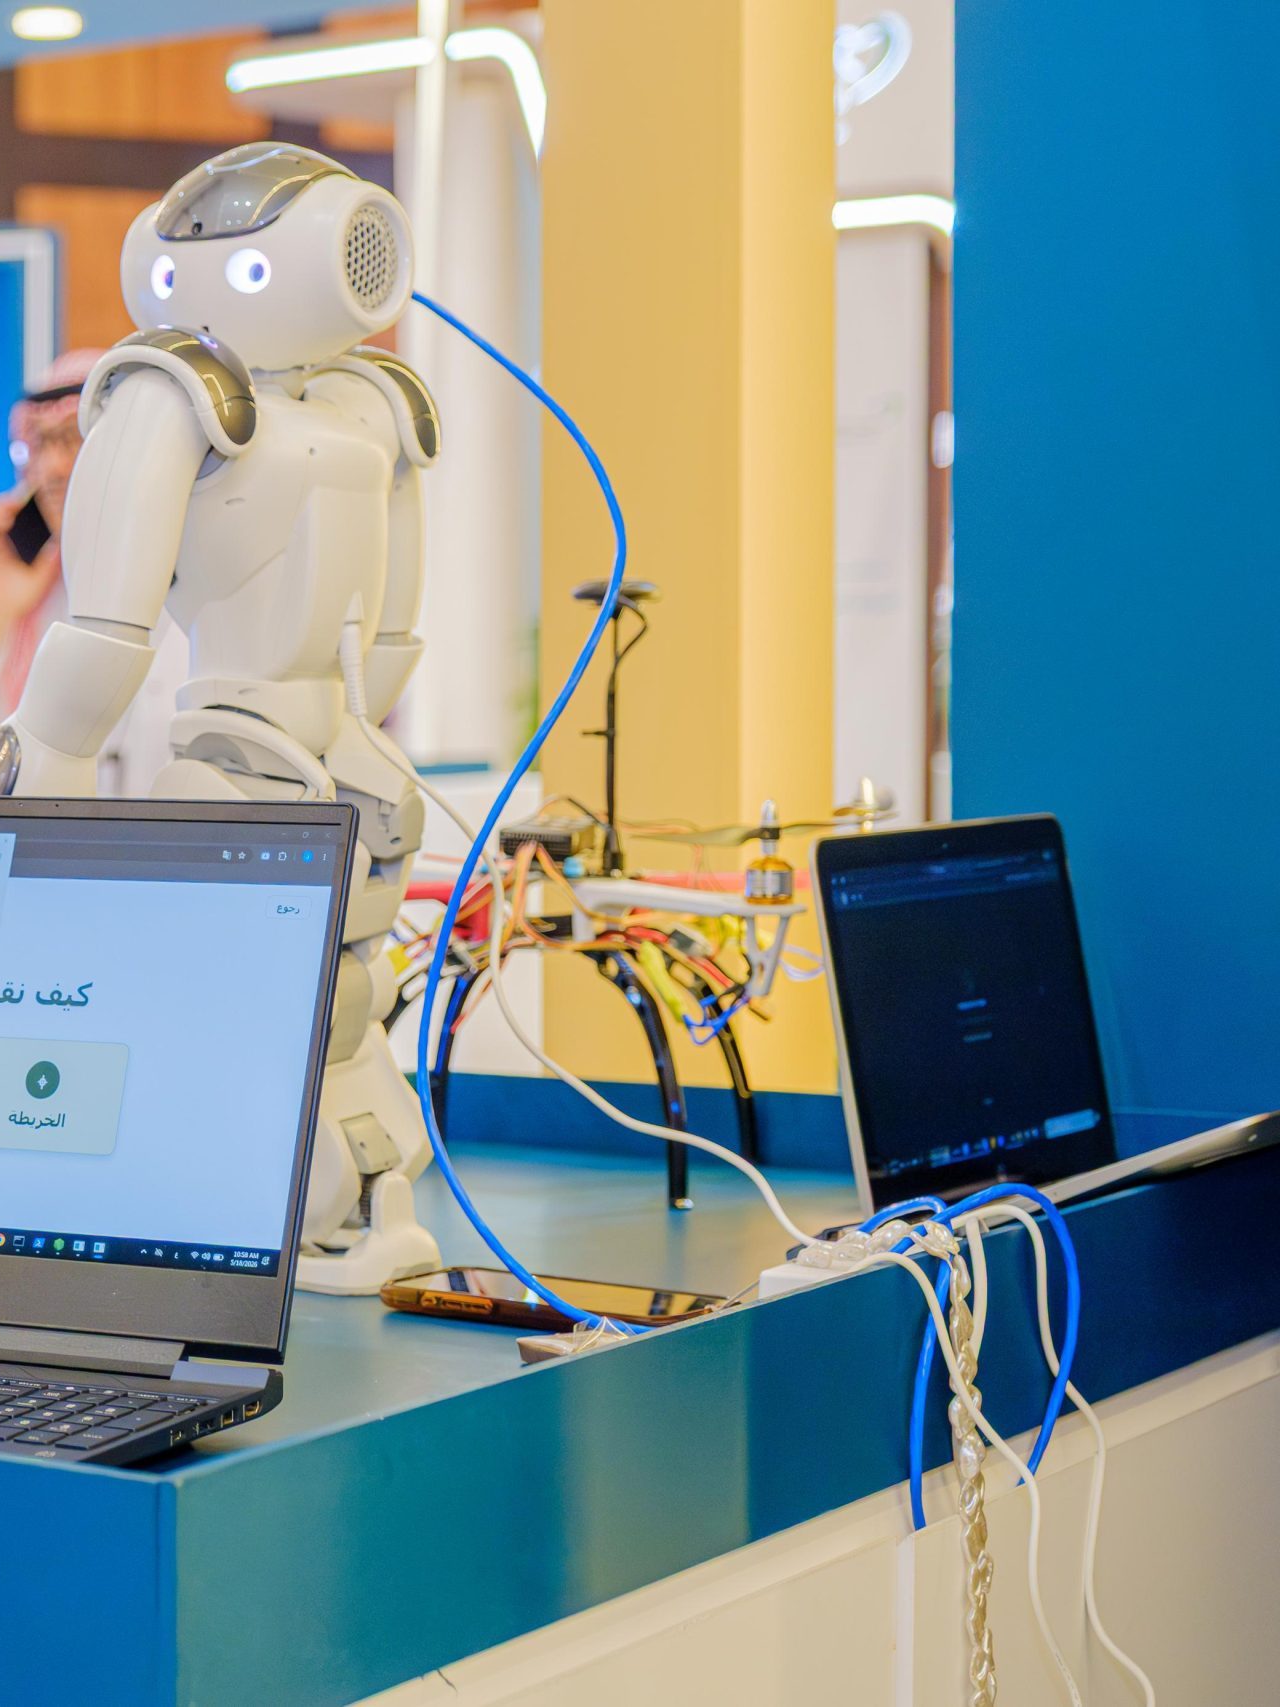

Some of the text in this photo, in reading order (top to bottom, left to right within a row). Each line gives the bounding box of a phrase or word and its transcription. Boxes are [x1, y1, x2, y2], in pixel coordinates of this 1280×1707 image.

[35, 981, 94, 1012] كيف
[8, 1110, 66, 1130] الخريطة
[249, 1251, 260, 1259] AM
